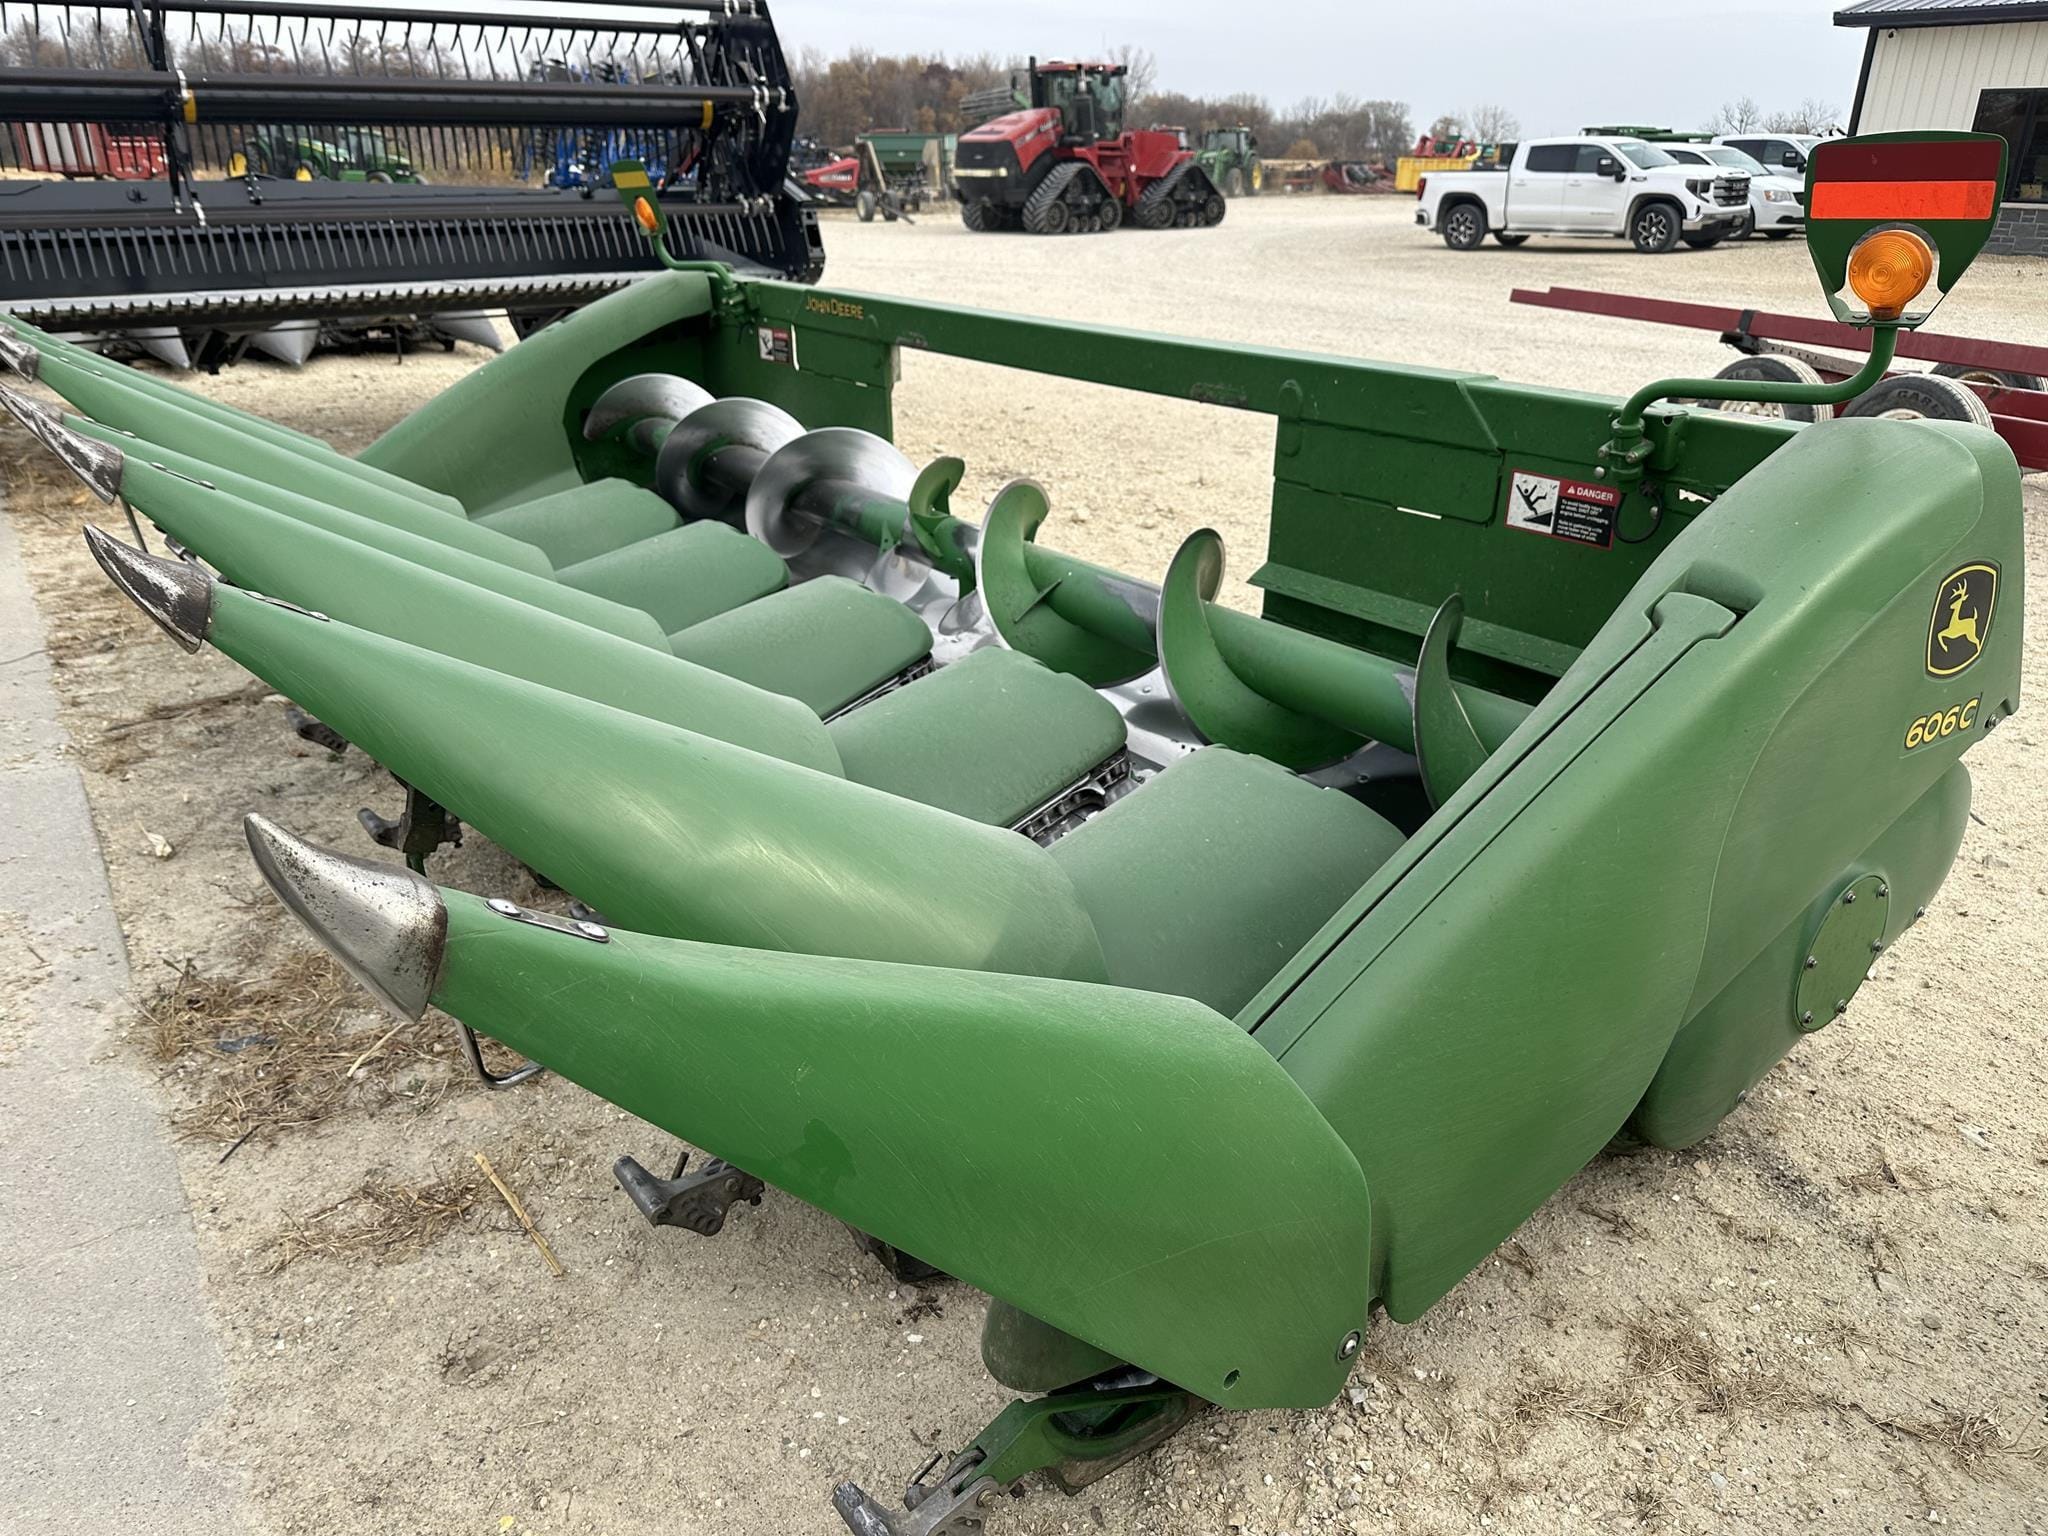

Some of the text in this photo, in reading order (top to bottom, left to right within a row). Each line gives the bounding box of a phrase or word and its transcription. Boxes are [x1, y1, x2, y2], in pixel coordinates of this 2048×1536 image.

[806, 296, 864, 320] JOHN DEERE
[1577, 488, 1613, 501] DANGER
[1904, 697, 1981, 750] 606C
